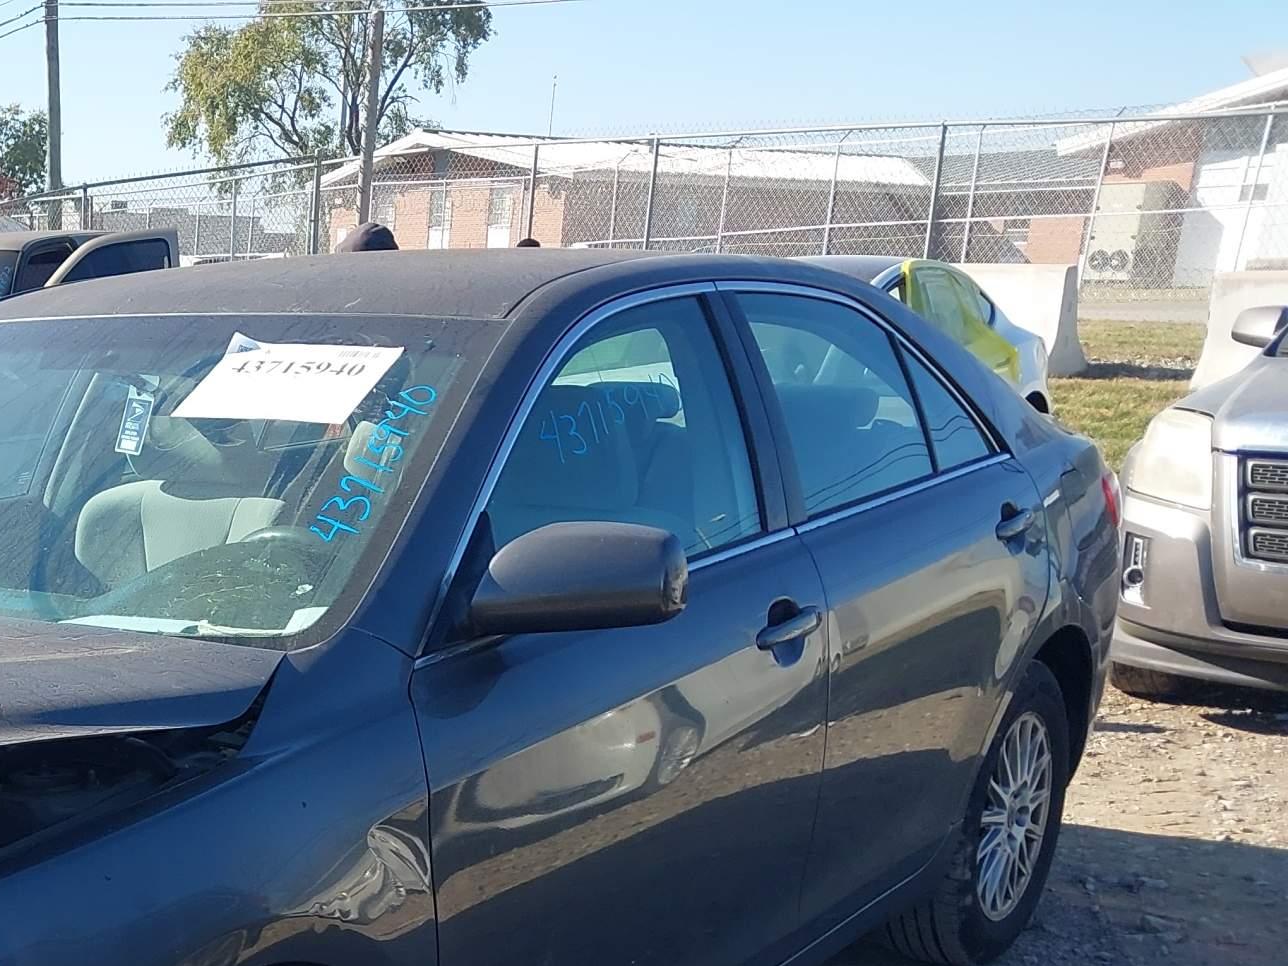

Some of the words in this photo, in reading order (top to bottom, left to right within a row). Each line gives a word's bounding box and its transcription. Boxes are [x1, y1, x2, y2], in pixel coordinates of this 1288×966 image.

[231, 360, 366, 376] 43715940
[539, 373, 683, 463] 43715940
[310, 385, 437, 542] 43715940
